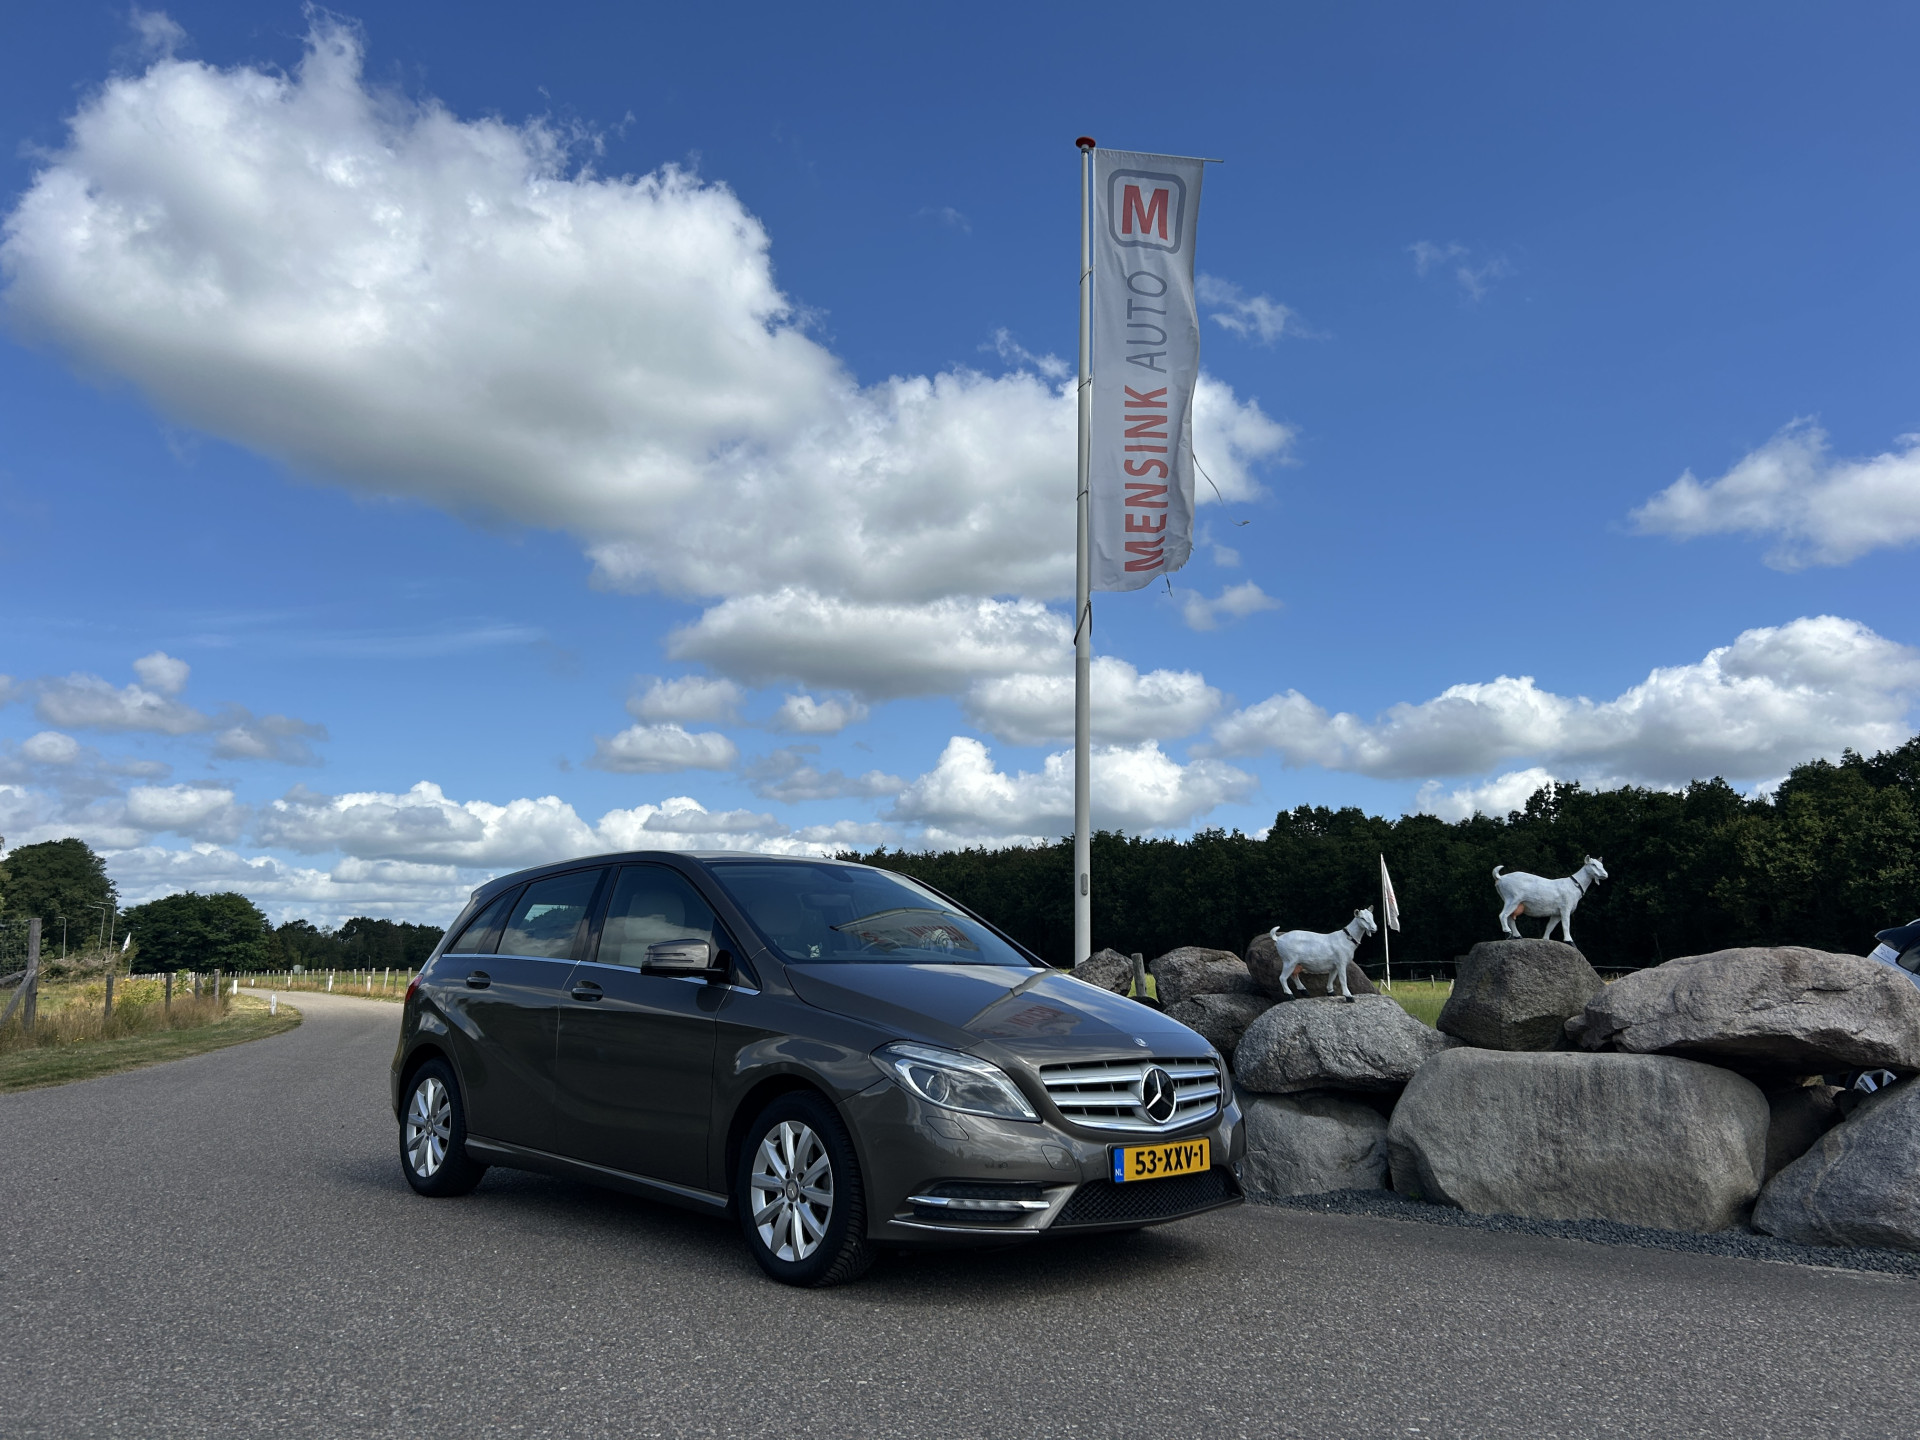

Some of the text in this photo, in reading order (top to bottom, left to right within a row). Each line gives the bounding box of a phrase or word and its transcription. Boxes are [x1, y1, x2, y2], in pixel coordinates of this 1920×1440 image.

[1121, 184, 1169, 241] M
[1123, 270, 1169, 572] MENSINK AUTO
[1115, 1143, 1204, 1177] NL 53-XXV-1
